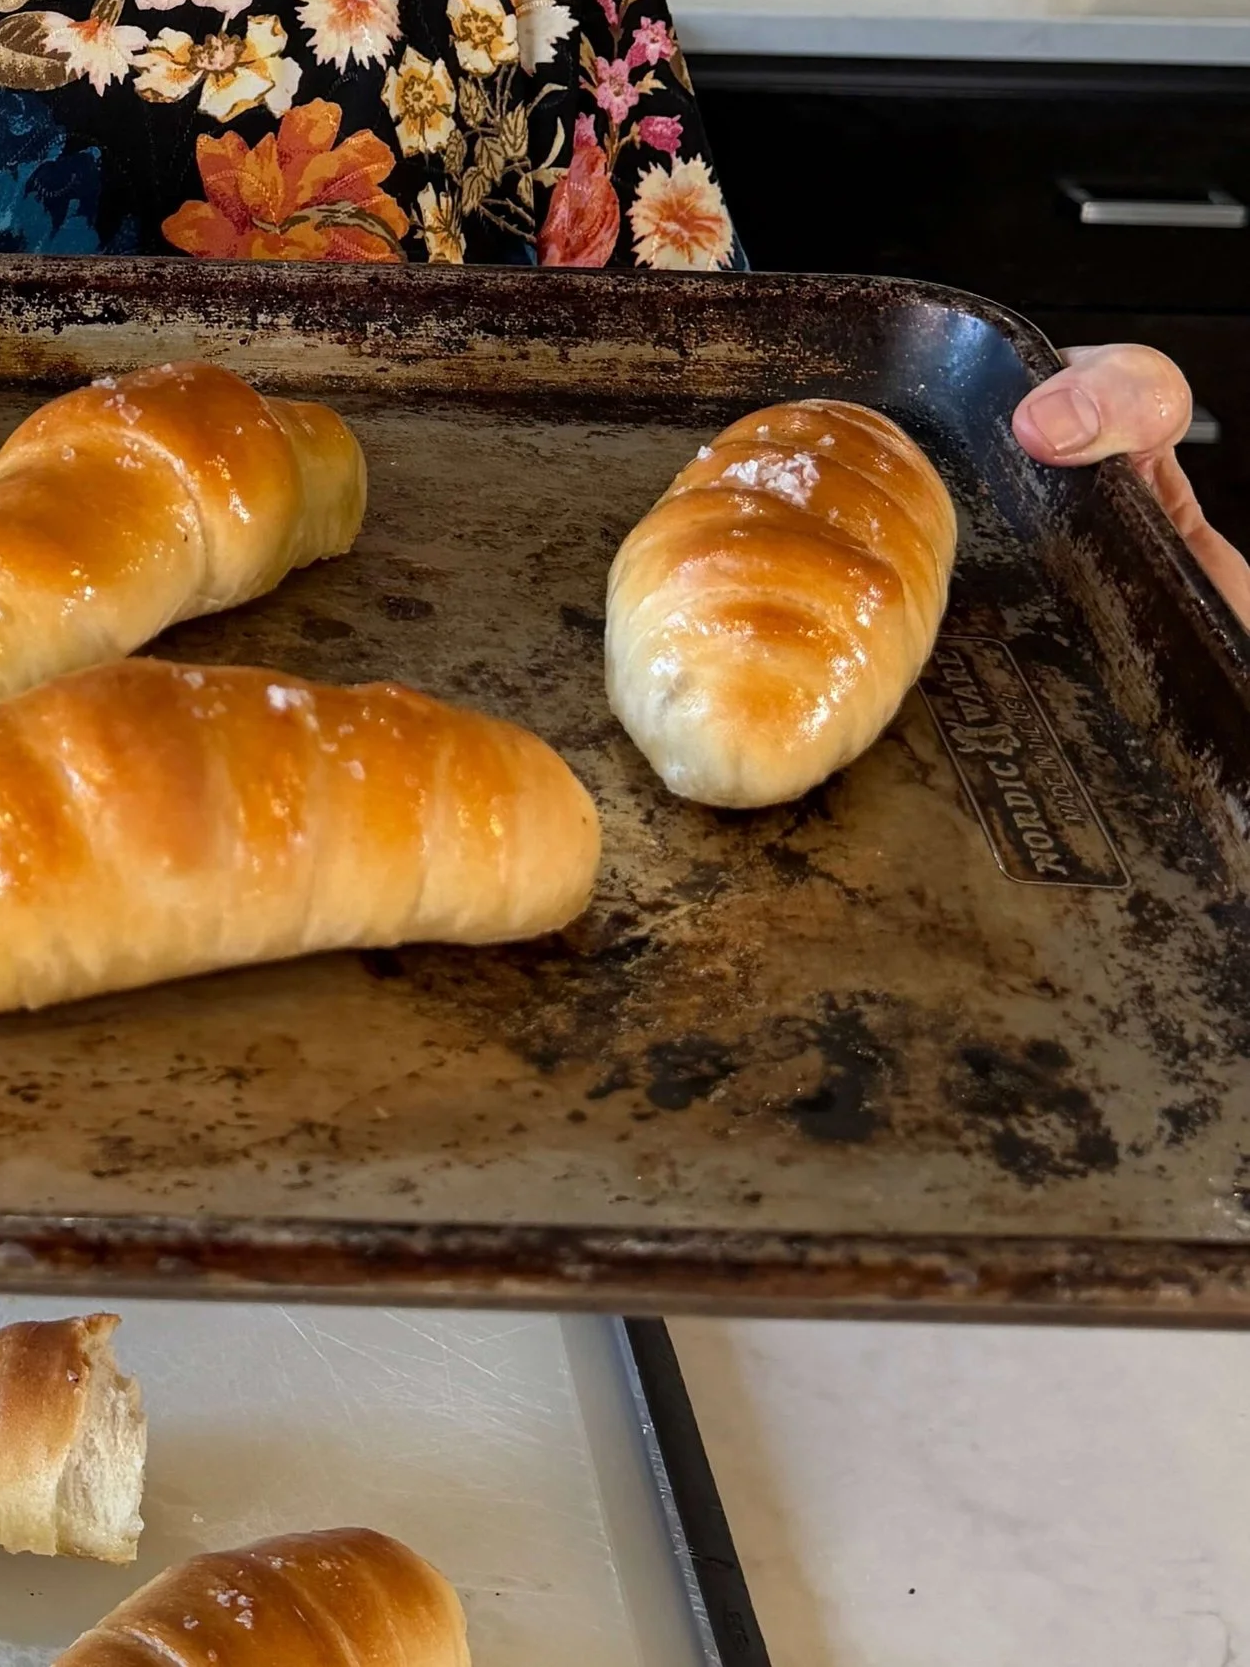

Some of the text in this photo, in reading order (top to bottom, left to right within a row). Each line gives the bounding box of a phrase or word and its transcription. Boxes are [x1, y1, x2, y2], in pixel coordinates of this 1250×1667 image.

[934, 650, 1068, 874] NORDIC WARE
[1033, 755, 1059, 769] IN
[1045, 776, 1086, 821] MADE
